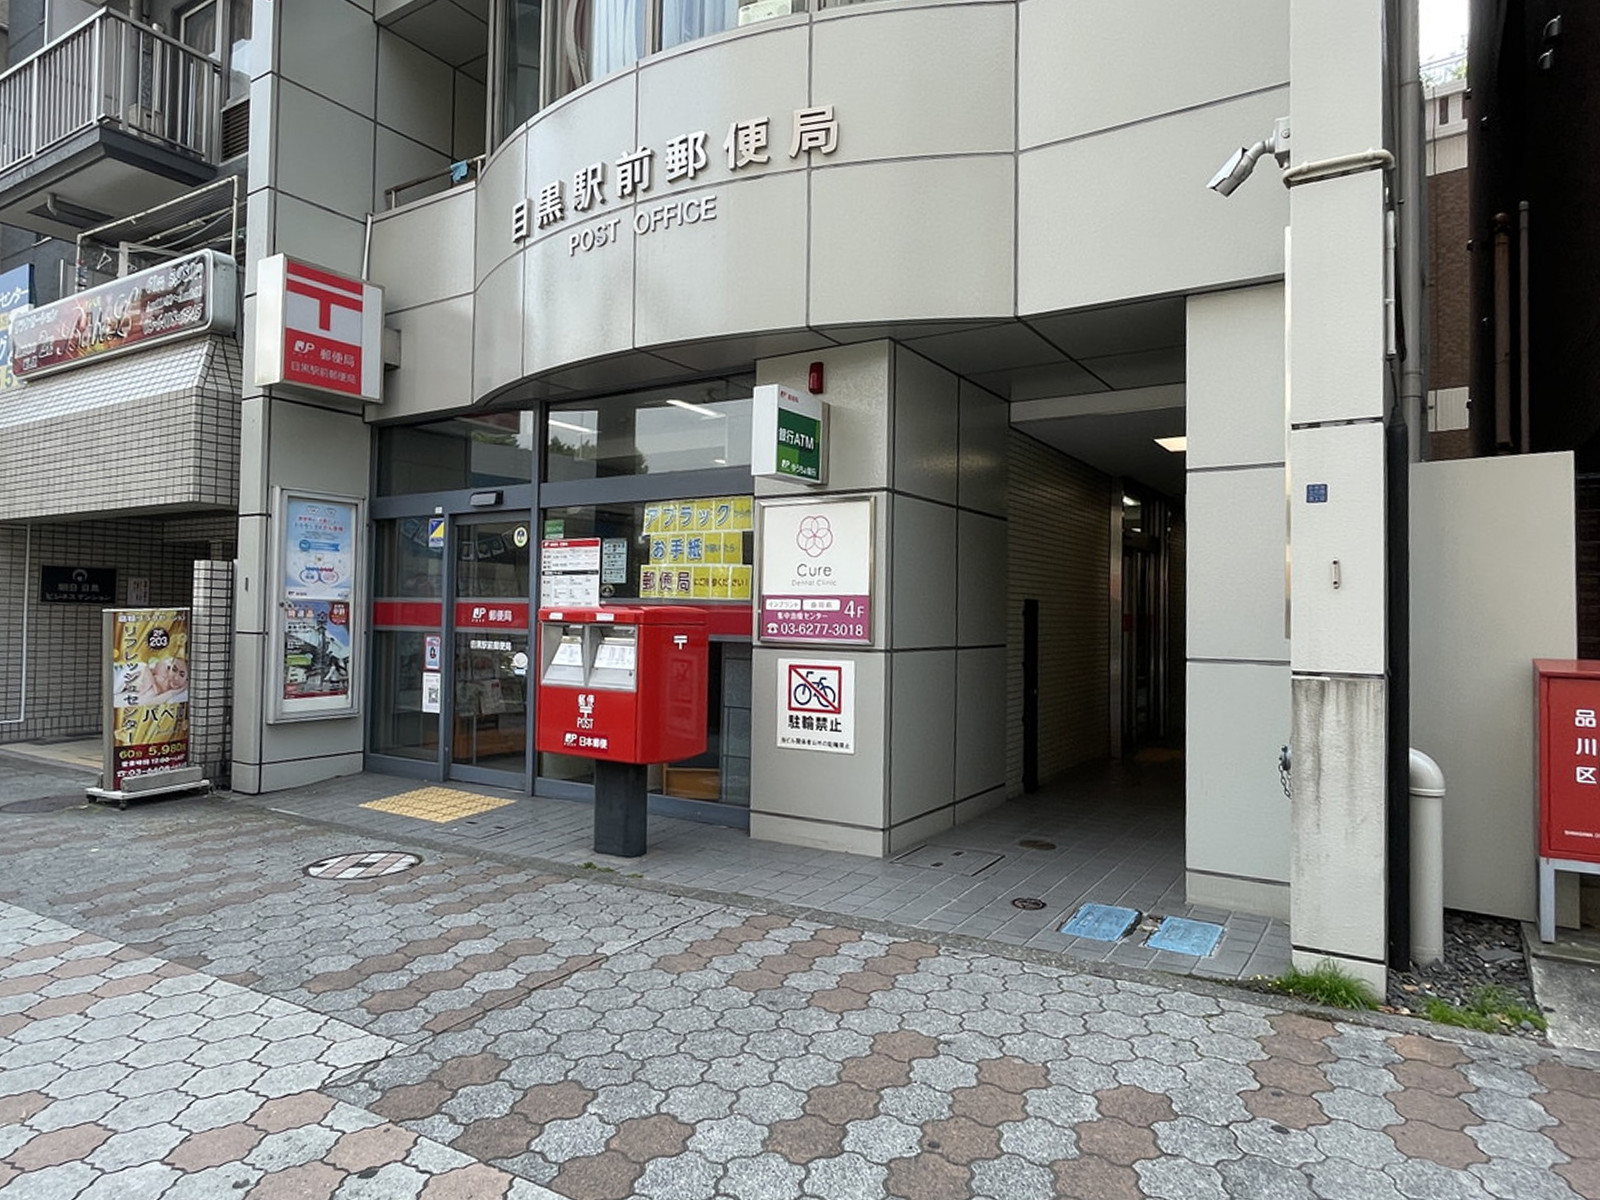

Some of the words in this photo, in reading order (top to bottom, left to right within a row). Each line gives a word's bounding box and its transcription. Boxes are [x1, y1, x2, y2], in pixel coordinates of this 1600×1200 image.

[512, 105, 839, 244] 目黒駅前郵便局
[569, 218, 620, 257] POST
[633, 195, 717, 235] OFFICE
[320, 349, 355, 368] 郵便局
[291, 360, 356, 384] 目黒駅前郵便局
[779, 427, 815, 450] 銀行ATM
[645, 505, 729, 529] アフラック
[796, 562, 833, 578] Cure
[791, 579, 815, 587] Dental
[816, 579, 837, 587] Clinic
[780, 622, 864, 637] 03-6277-3018
[149, 636, 168, 648] 203
[121, 625, 139, 744] リフレッシュセンター
[577, 716, 594, 729] POST
[788, 714, 843, 733] 駐輪禁止
[579, 736, 608, 750] 日本郵便
[1575, 708, 1598, 784] 品川区
